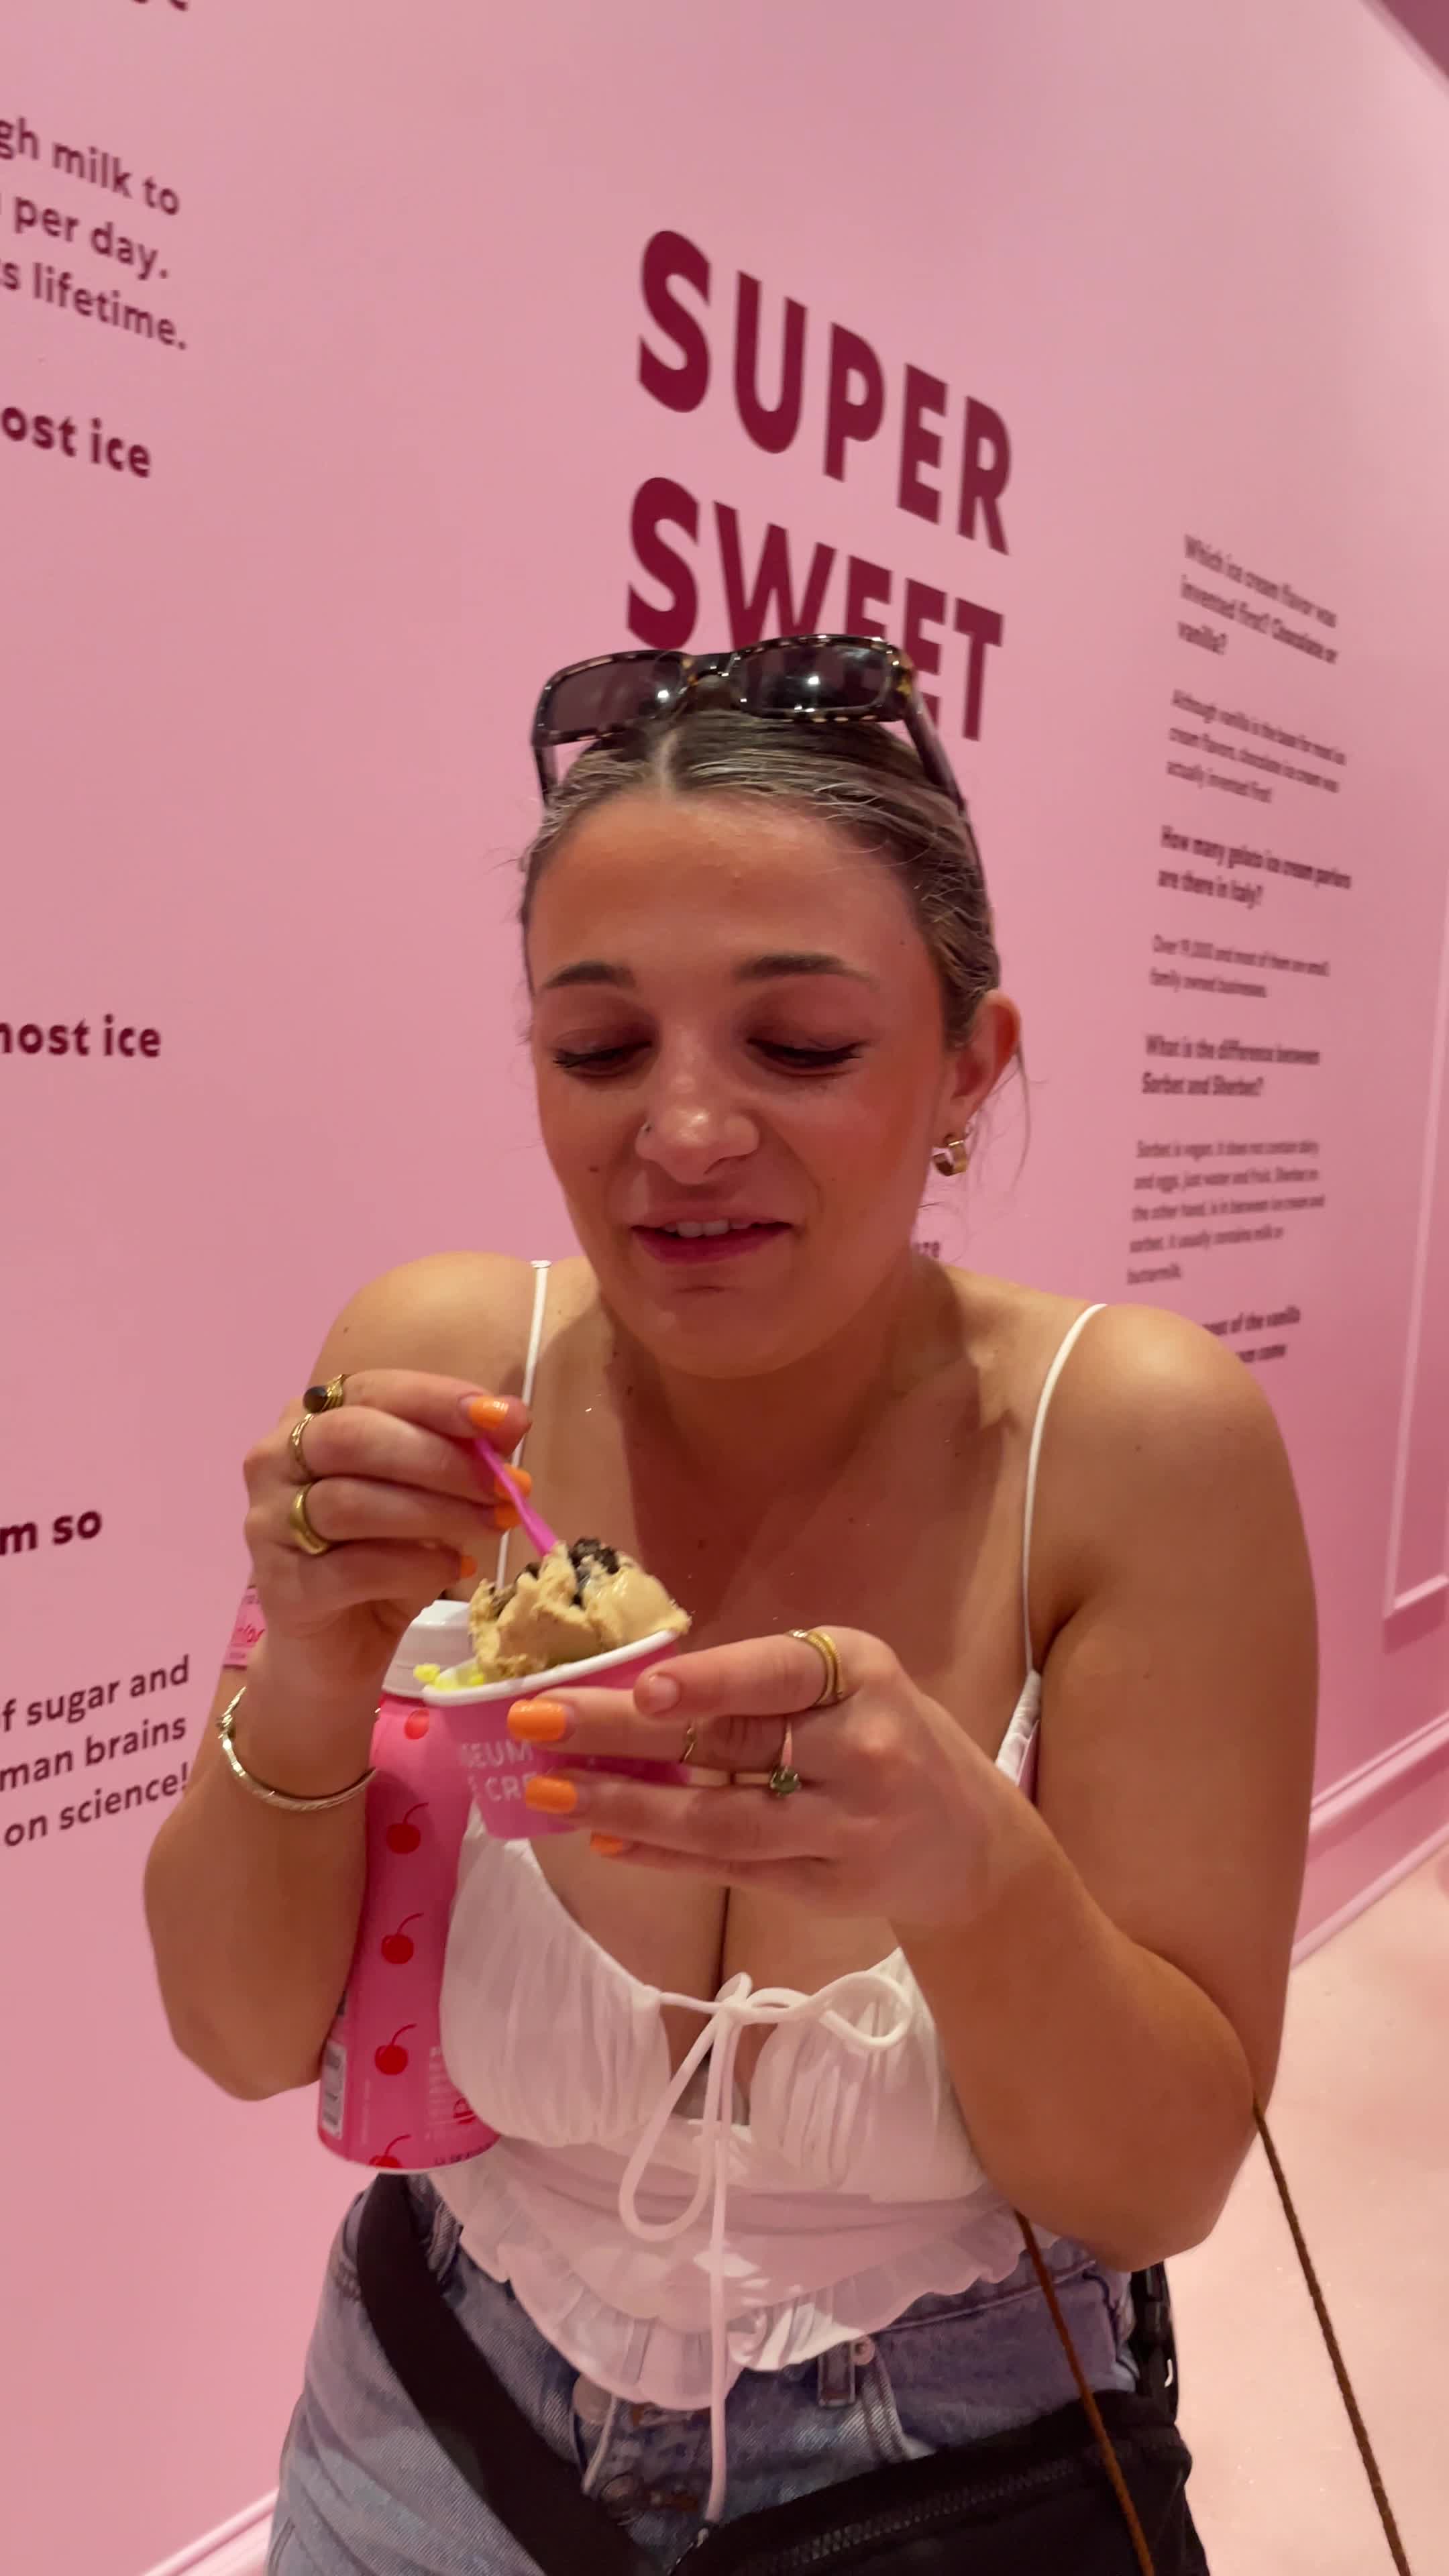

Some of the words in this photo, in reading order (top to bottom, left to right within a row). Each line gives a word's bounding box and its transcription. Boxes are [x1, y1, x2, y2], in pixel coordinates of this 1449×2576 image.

[53, 142, 132, 199] milk
[142, 176, 179, 215] to
[15, 197, 79, 242] per
[91, 221, 168, 280] day.
[0, 260, 19, 290] s
[33, 262, 187, 350] lifetime.
[639, 230, 1011, 555] SUPER
[91, 417, 150, 478] ice
[627, 477, 1004, 741] SWEET
[104, 1014, 161, 1057] ice
[53, 1511, 102, 1545] so
[27, 1680, 120, 1723] sugar
[130, 1654, 189, 1698] and
[0, 1750, 73, 1792] man
[85, 1718, 186, 1766] brains
[4, 1815, 47, 1846] on
[59, 1762, 187, 1830] science!
